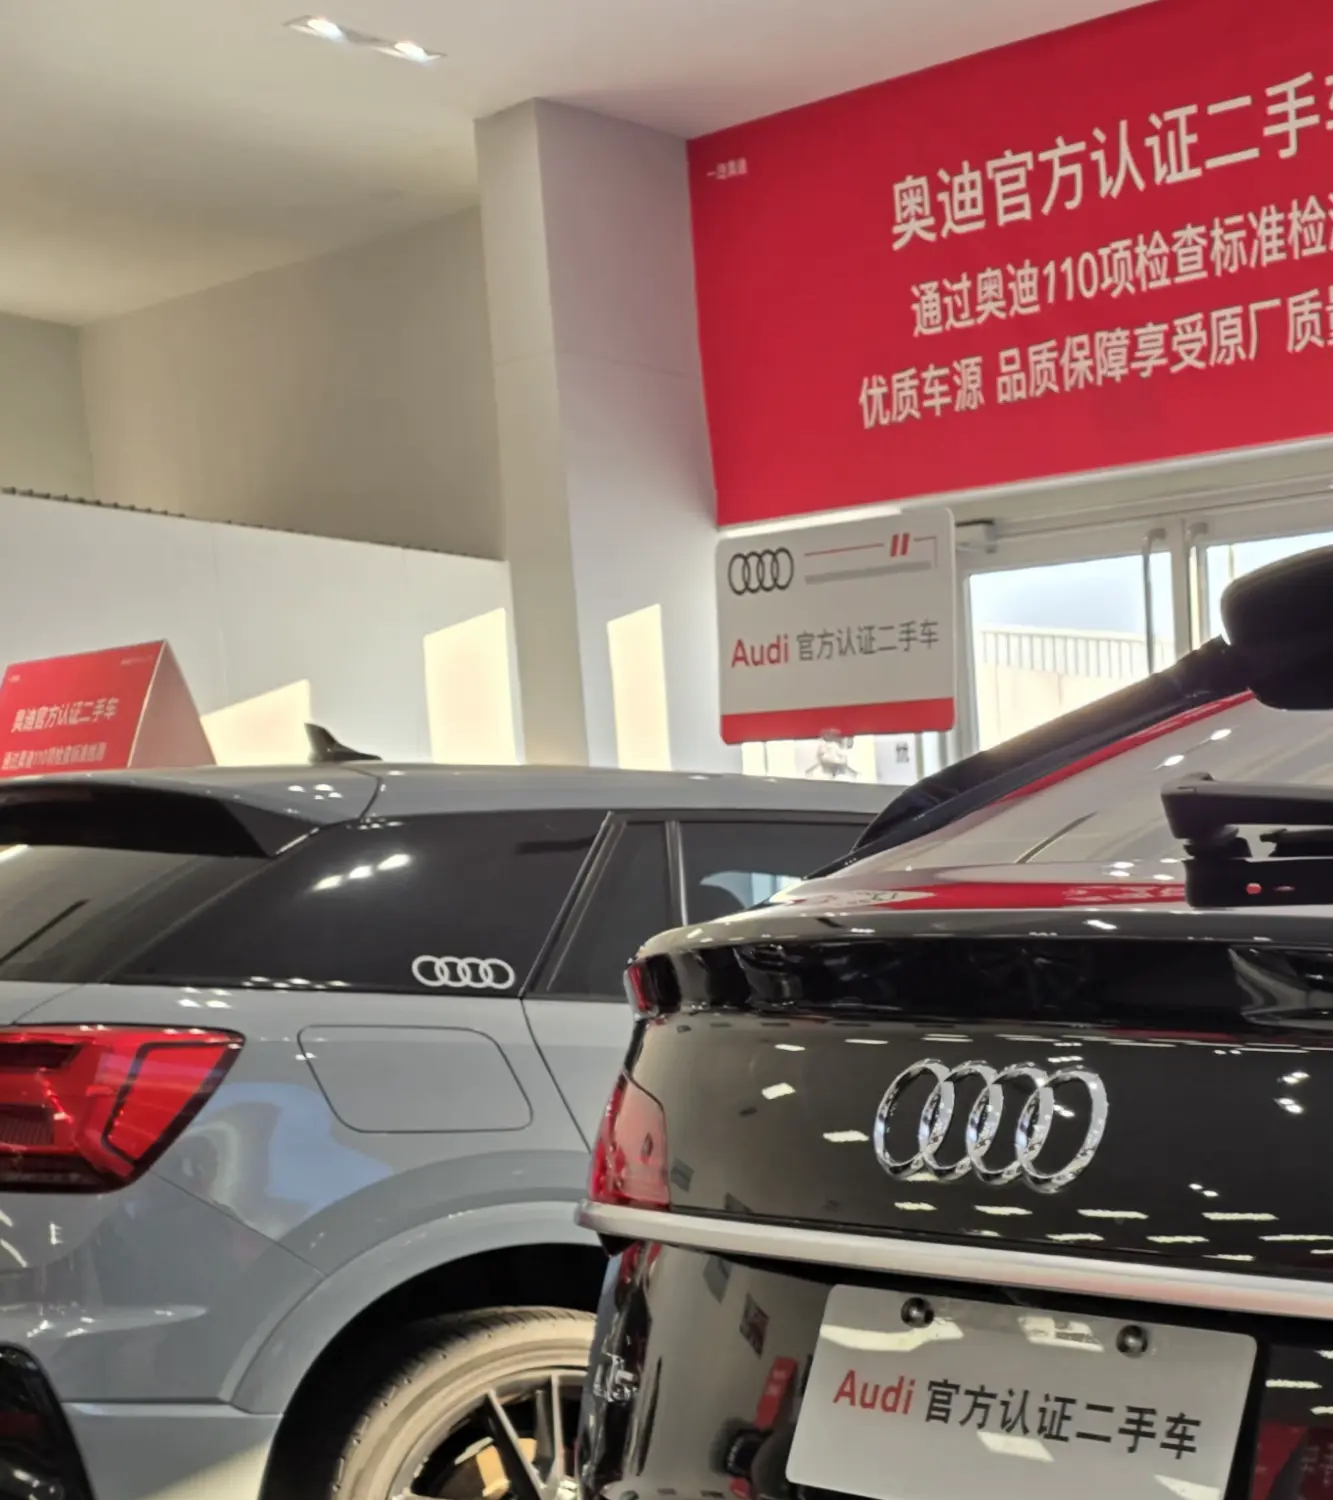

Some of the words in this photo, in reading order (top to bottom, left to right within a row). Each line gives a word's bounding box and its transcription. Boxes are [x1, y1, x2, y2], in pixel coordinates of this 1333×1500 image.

[858, 355, 985, 431] 优质车源
[731, 634, 789, 668] Audi
[796, 618, 939, 662] 官方认证二手车
[833, 1369, 915, 1415] Audi
[925, 1378, 1202, 1460] 官方认证二手车
